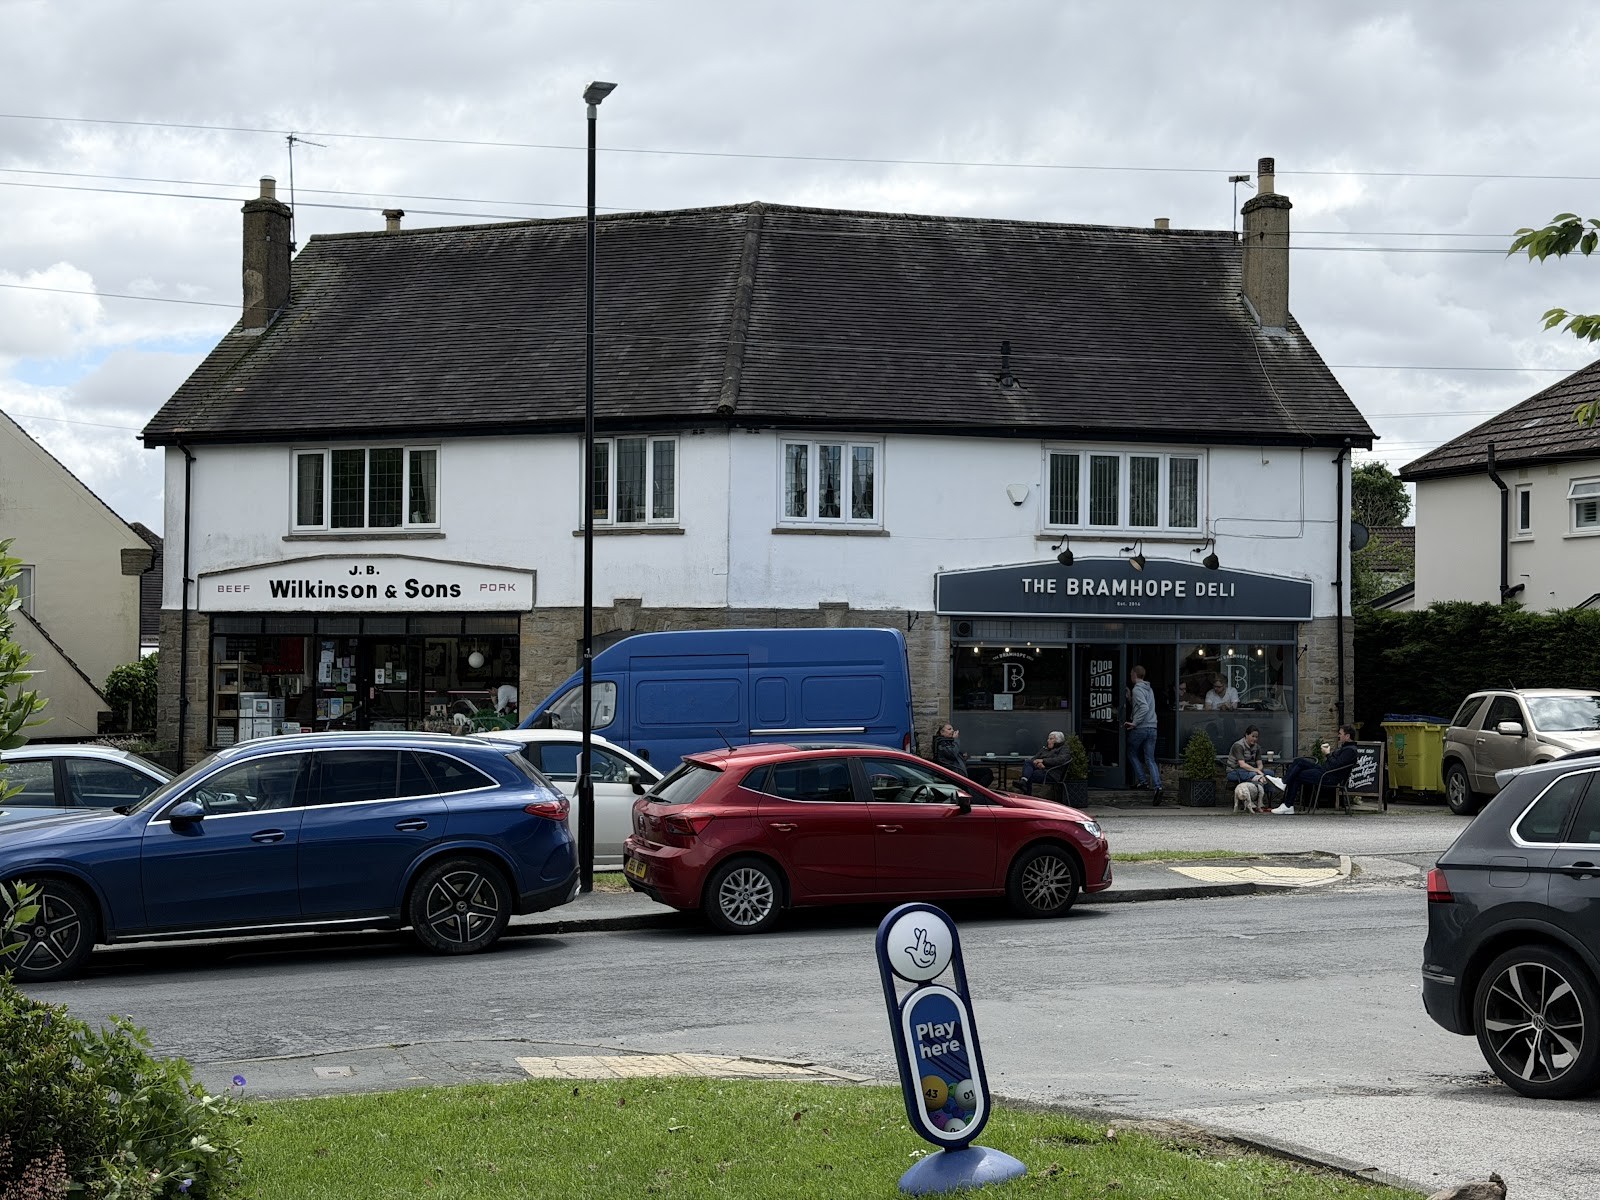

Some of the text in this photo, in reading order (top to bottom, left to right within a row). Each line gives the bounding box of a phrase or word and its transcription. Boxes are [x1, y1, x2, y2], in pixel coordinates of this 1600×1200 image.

[217, 584, 250, 593] BEEF
[269, 578, 461, 599] Wilkinson & Sons
[479, 583, 516, 592] PORK
[1021, 577, 1235, 598] THE BRAMHOPE DELI
[1090, 660, 1112, 675] GOOD
[1002, 662, 1026, 694] B
[1090, 673, 1113, 687] FOOD
[1090, 693, 1112, 708] GOOD
[1090, 707, 1112, 720] MOOD
[915, 1020, 956, 1041] Play
[919, 1039, 960, 1059] here
[925, 1088, 939, 1099] 43
[963, 1089, 974, 1100] 01
